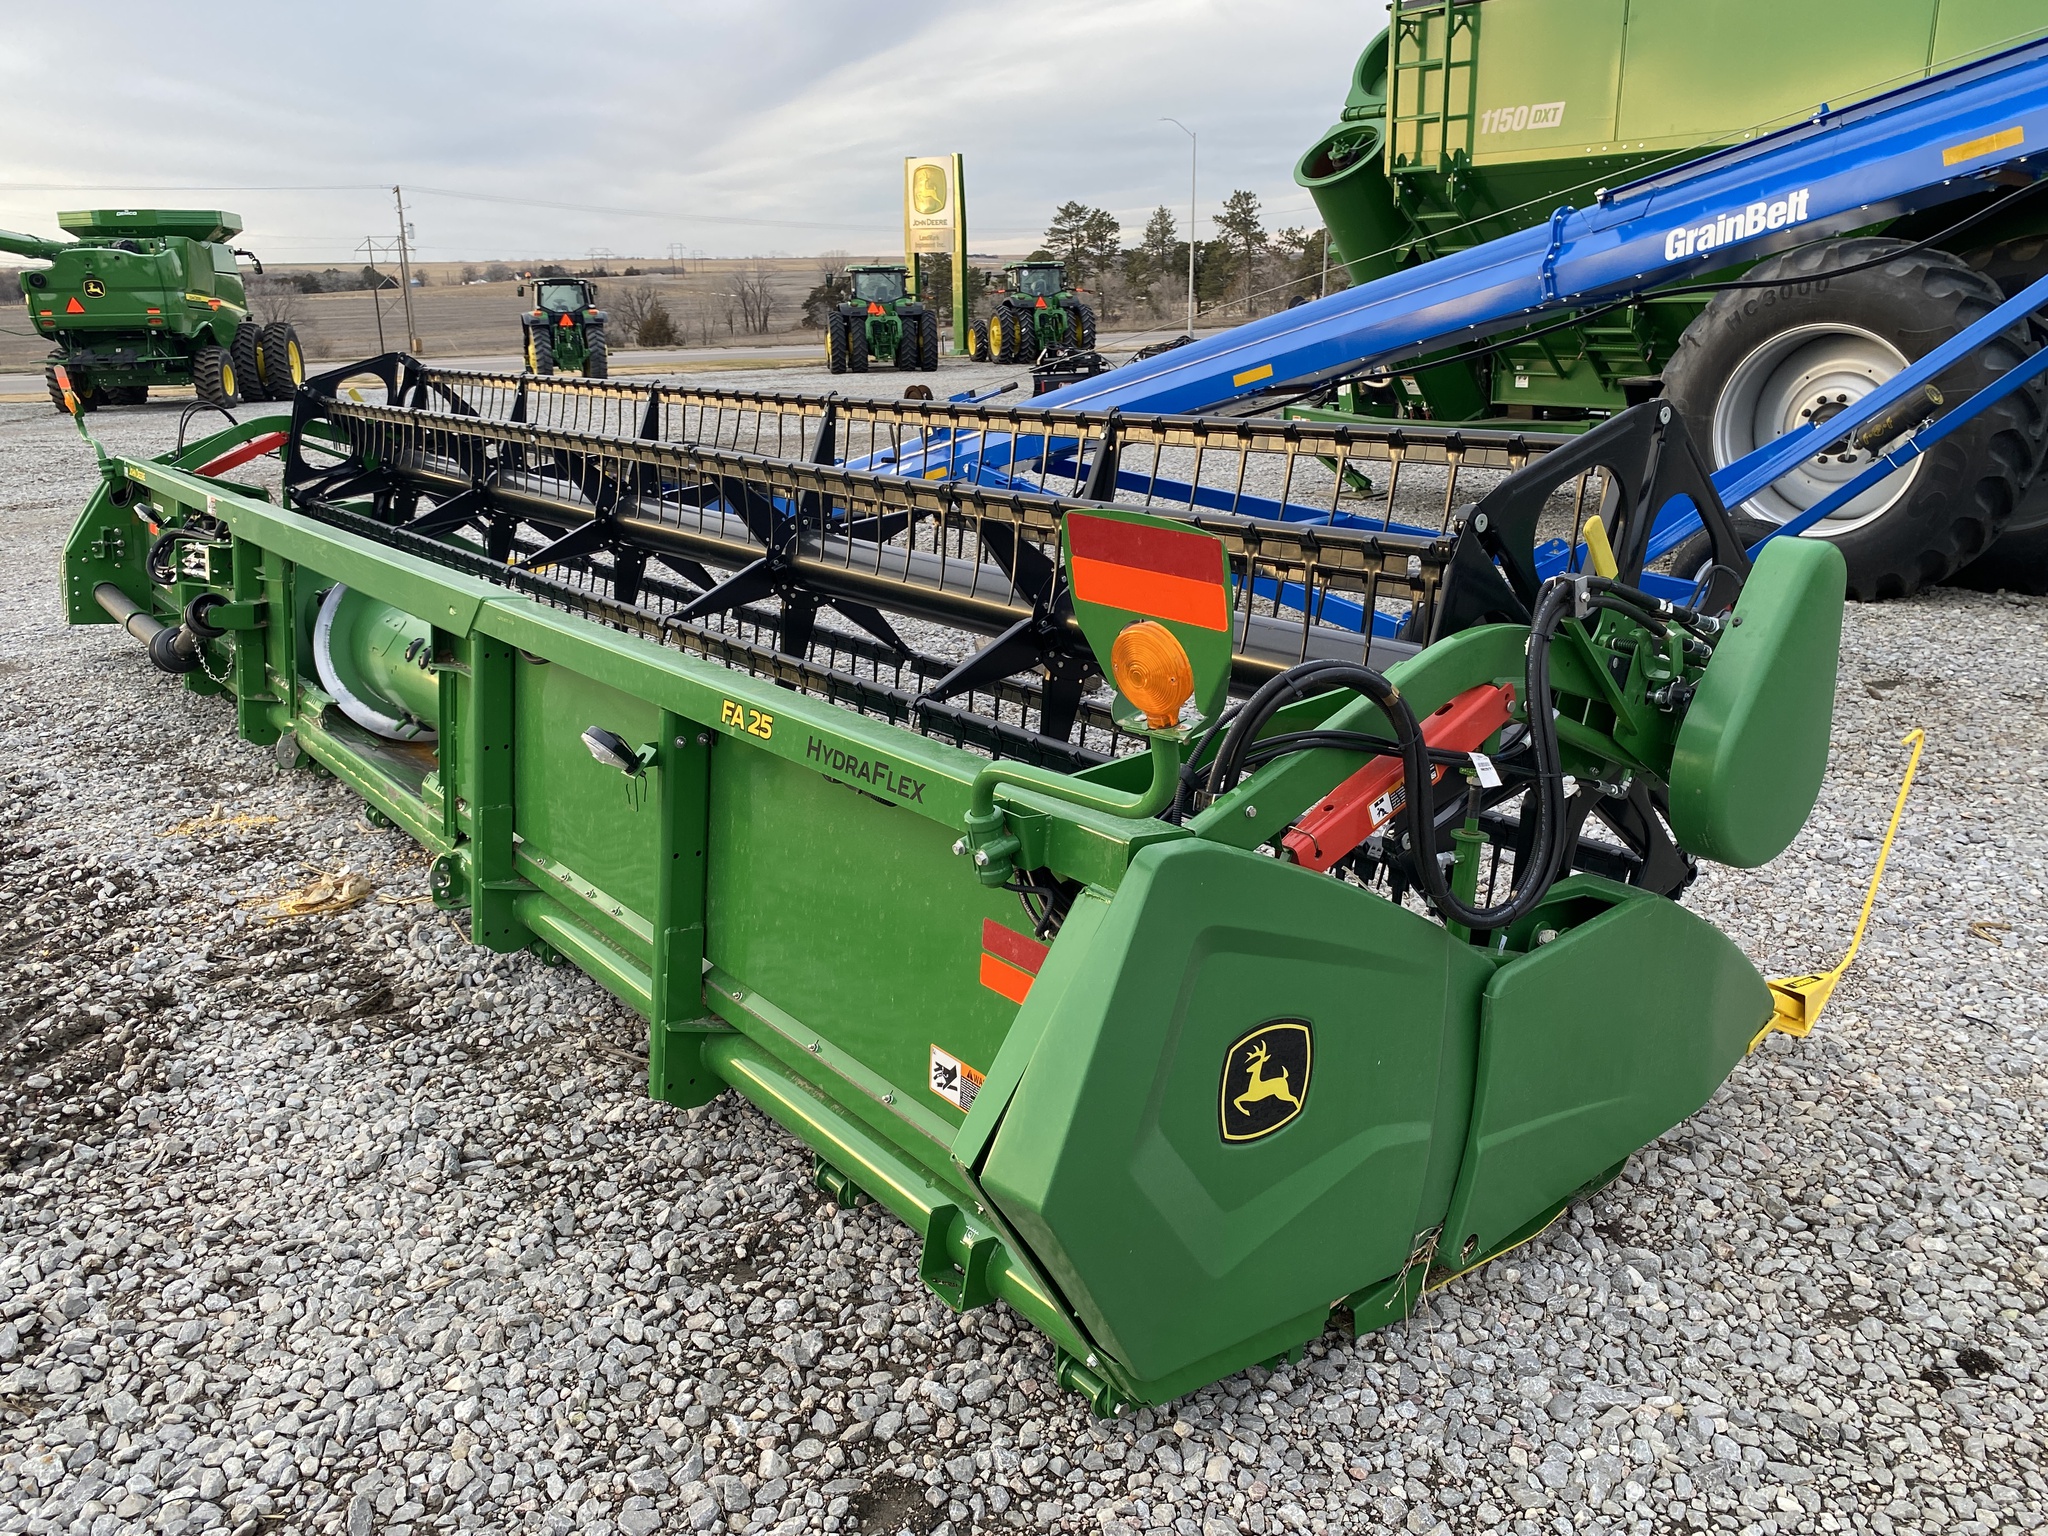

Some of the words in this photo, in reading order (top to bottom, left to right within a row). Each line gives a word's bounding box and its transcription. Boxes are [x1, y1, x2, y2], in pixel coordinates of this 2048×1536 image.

[1481, 105, 1529, 135] 1150
[1532, 107, 1560, 124] DXT
[926, 218, 948, 226] DEERE
[1664, 187, 1810, 261] GrainBelt
[721, 699, 745, 731] FA
[747, 708, 774, 740] 25
